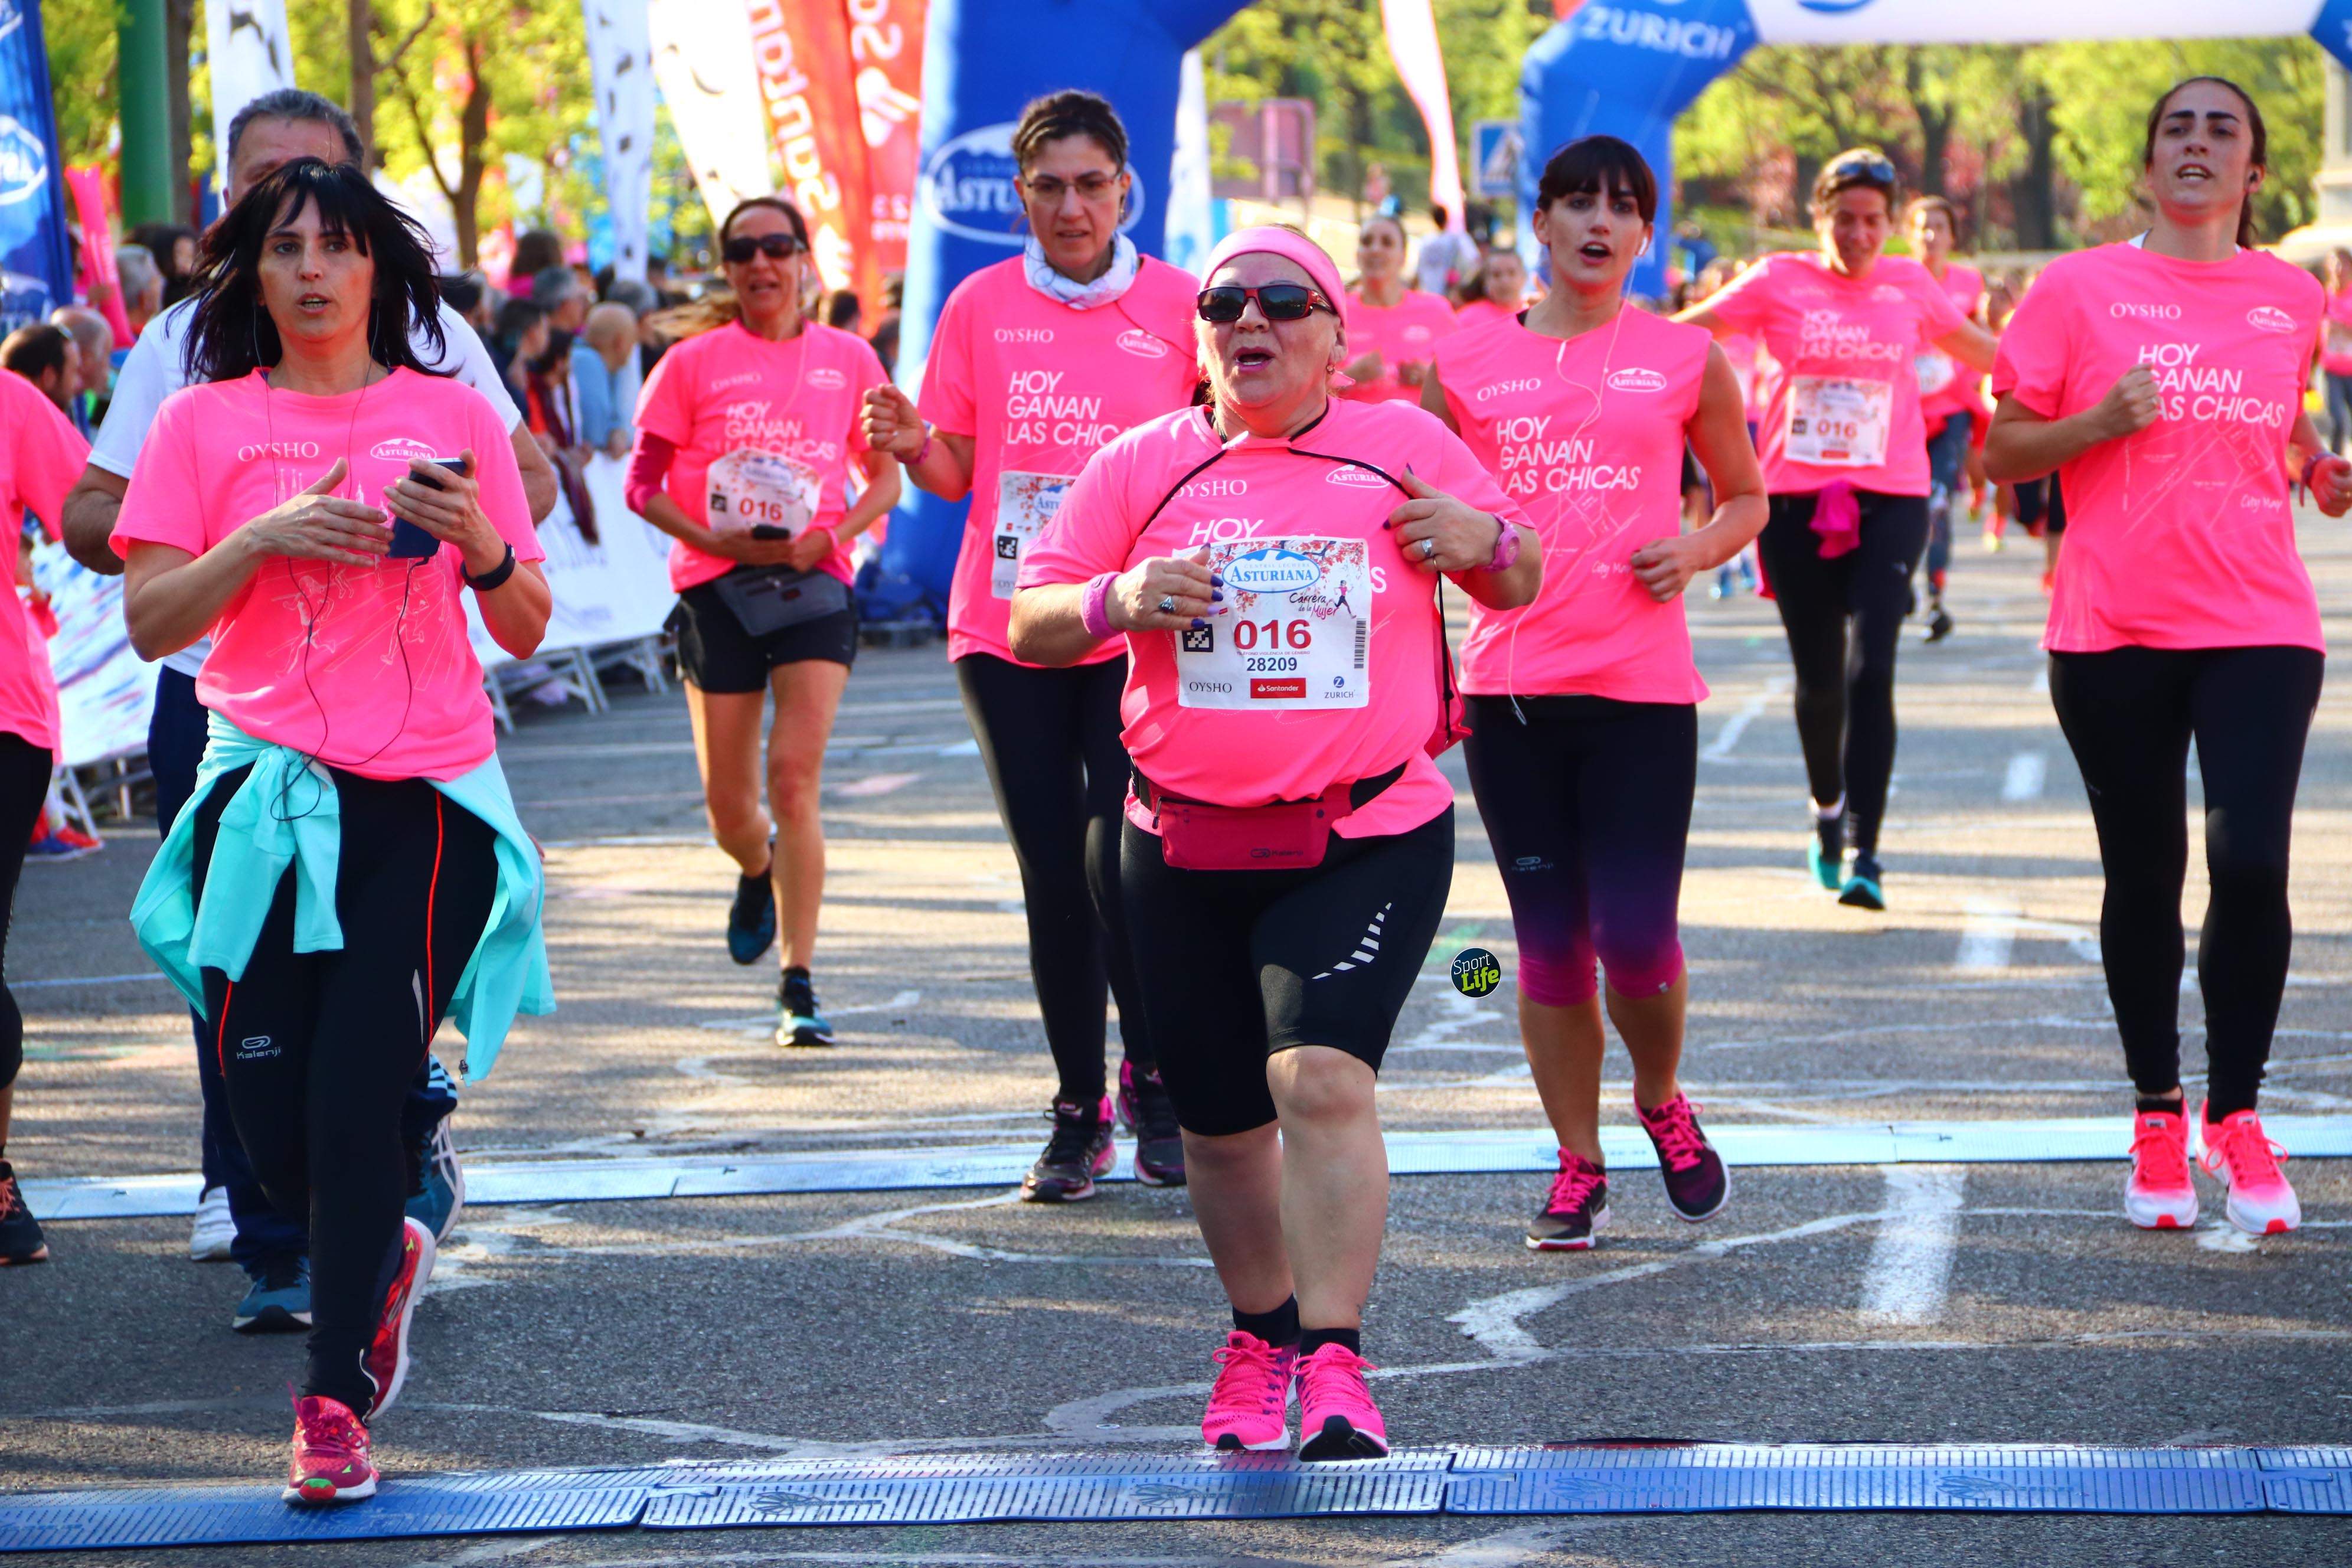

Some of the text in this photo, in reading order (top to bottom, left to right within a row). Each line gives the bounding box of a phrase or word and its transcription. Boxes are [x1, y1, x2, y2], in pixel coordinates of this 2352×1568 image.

[1580, 6, 1735, 60] ZURICH
[2110, 302, 2181, 319] OYSHO
[994, 328, 1054, 343] OYSHO
[2138, 343, 2201, 367] HOY
[1008, 370, 1064, 394] HOY
[1477, 378, 1541, 401] OYSHO
[727, 401, 772, 420] HOY
[1007, 396, 1102, 420] GANAN
[2158, 395, 2285, 429] AS CHICAS
[724, 420, 803, 439] GANAN
[1007, 422, 1130, 446] LAS CHIC
[1497, 415, 1551, 445] HOY
[1817, 419, 1857, 438] 016
[238, 441, 319, 462] OYSHO
[376, 447, 432, 459] ASTURIANA
[1501, 439, 1594, 470] GANAN
[1332, 473, 1387, 484] ASTURIAN
[1546, 465, 1641, 492] CHICAS
[740, 498, 783, 521] 016
[1188, 518, 1264, 545] HOY
[1230, 566, 1314, 582] ASTURIANA
[1289, 592, 1327, 603] Carrera
[1310, 602, 1340, 620] Mujer
[1234, 619, 1312, 650] 016
[1247, 658, 1298, 671] 28209
[1189, 681, 1232, 694] OYSHO
[236, 1046, 281, 1060] Kalenji
